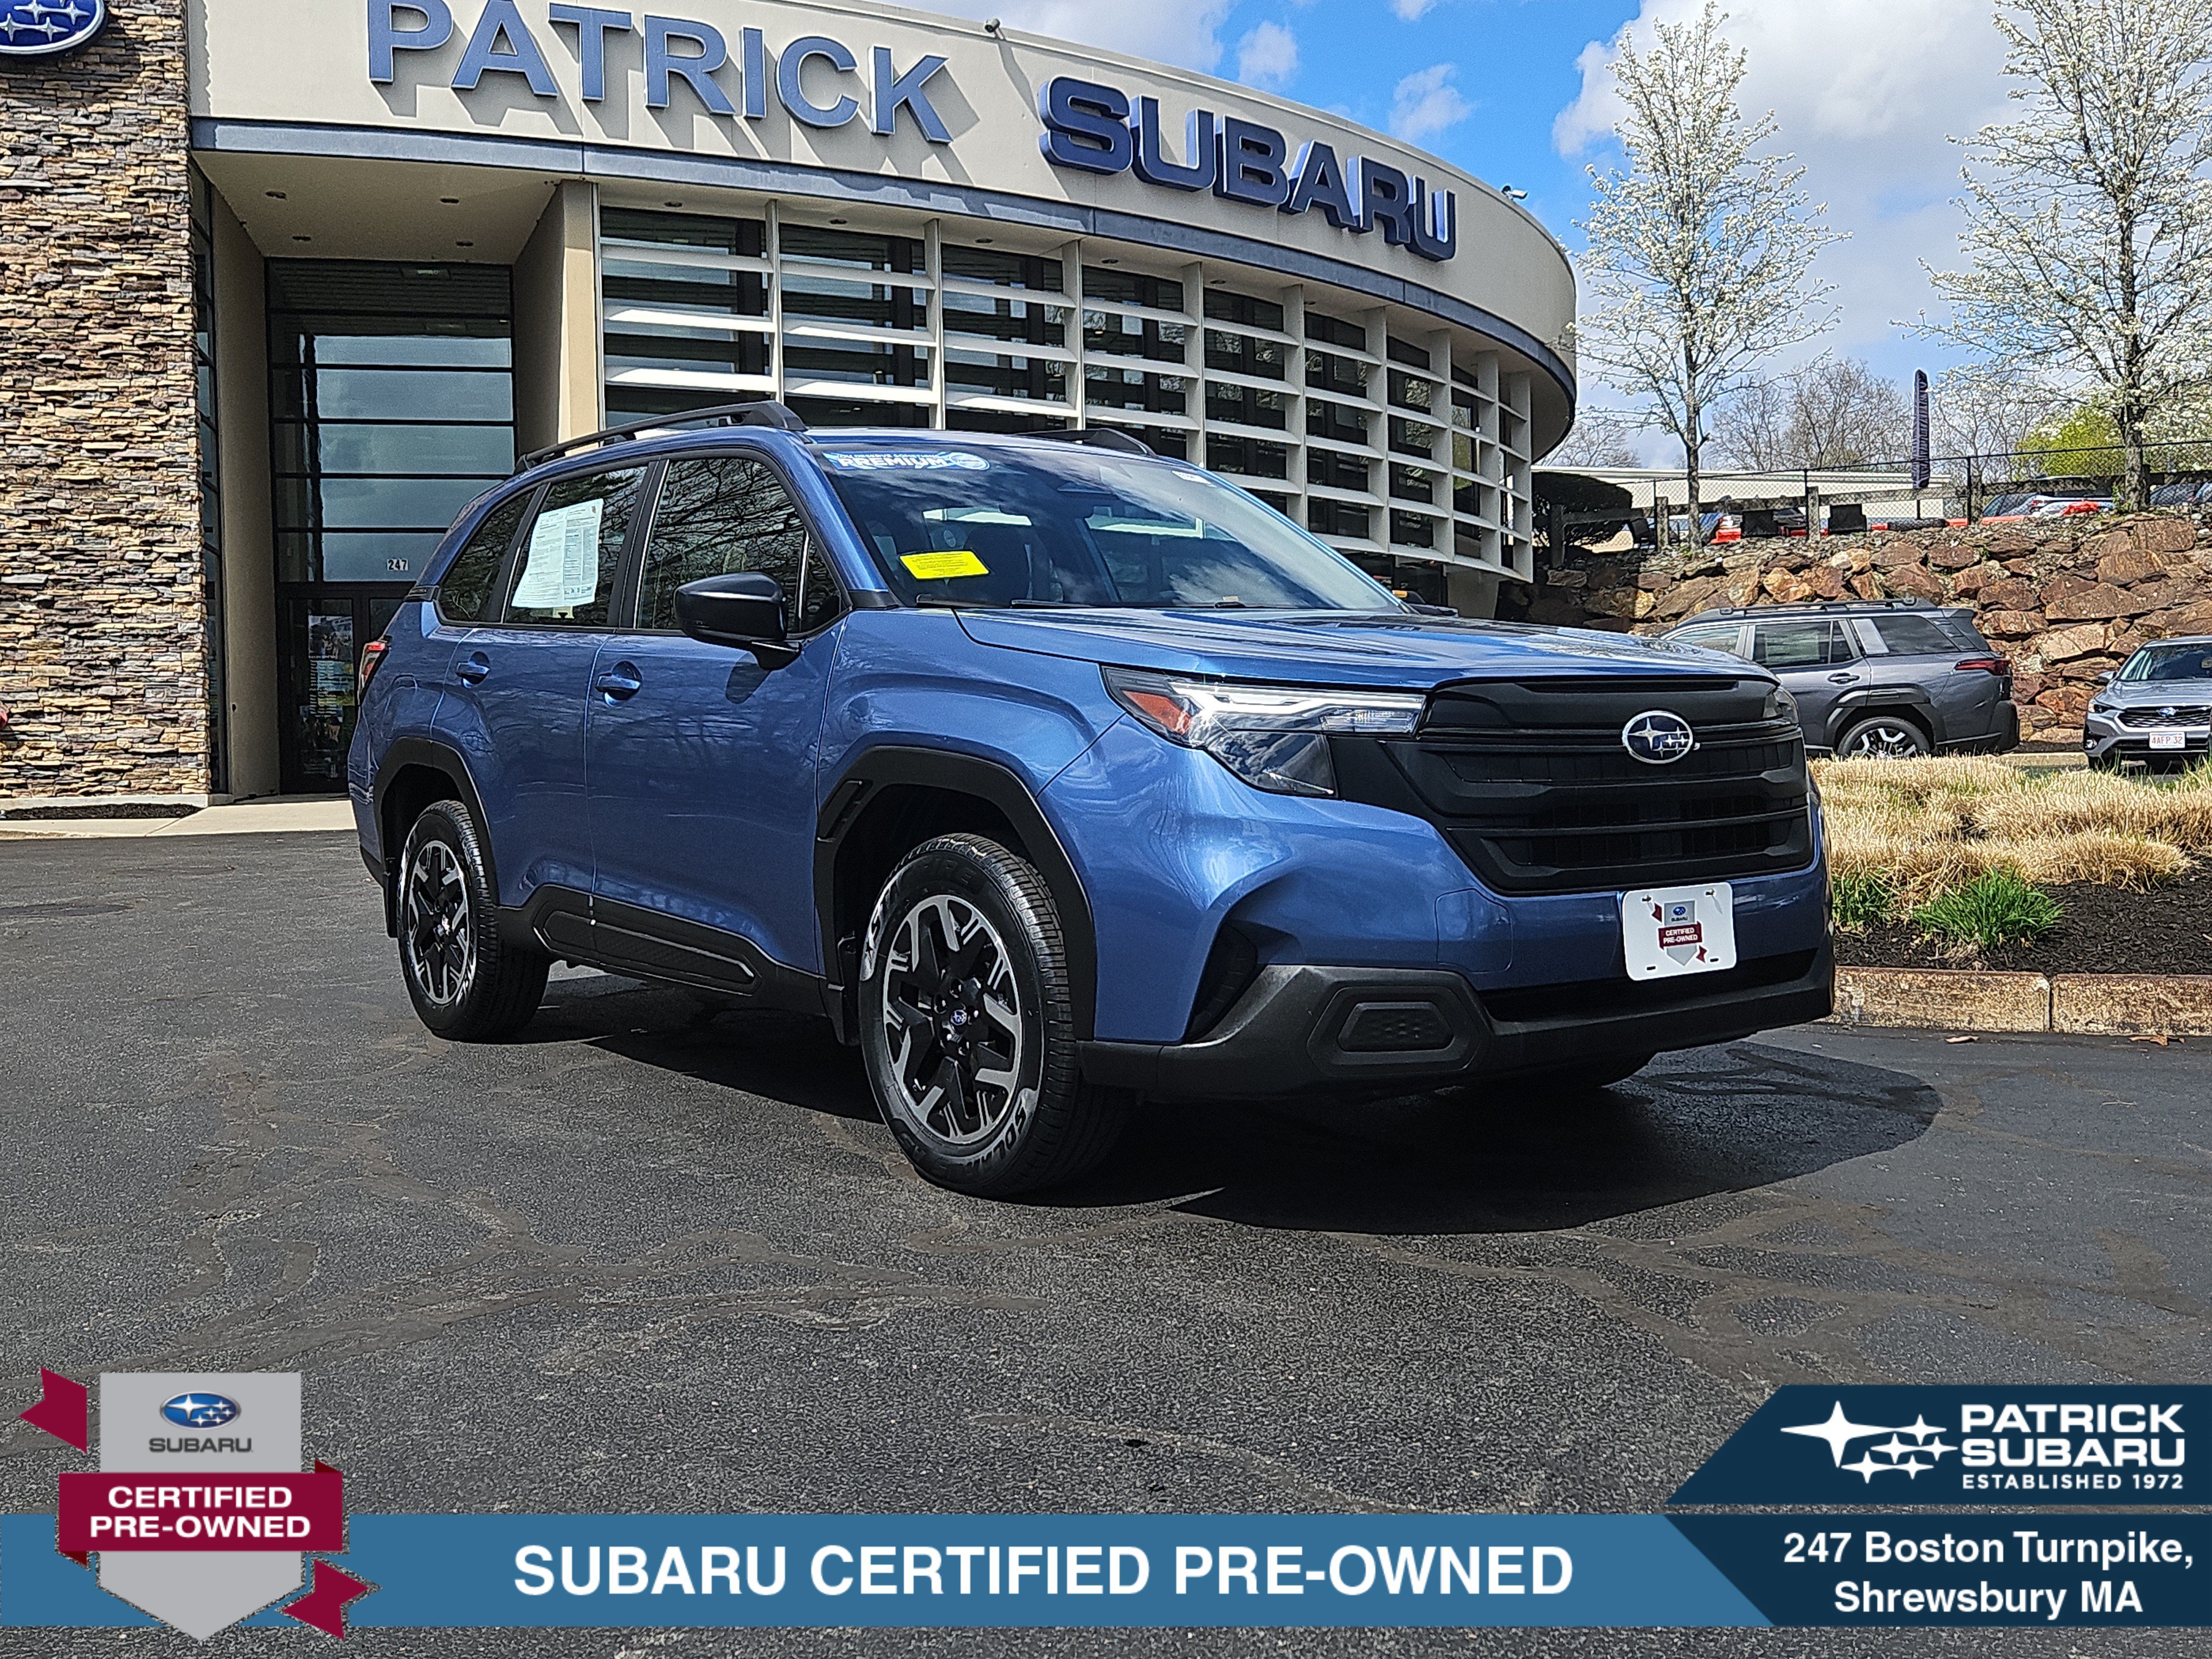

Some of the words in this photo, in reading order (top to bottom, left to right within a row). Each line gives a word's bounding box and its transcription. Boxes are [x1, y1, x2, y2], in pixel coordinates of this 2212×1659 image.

[368, 0, 953, 143] PATRICK
[1039, 75, 1456, 261] SUBARU
[837, 457, 948, 467] PREMIUM
[388, 559, 407, 570] 247
[1666, 928, 1694, 936] CERTIFIED
[1663, 934, 1697, 944] PRE-OWNED
